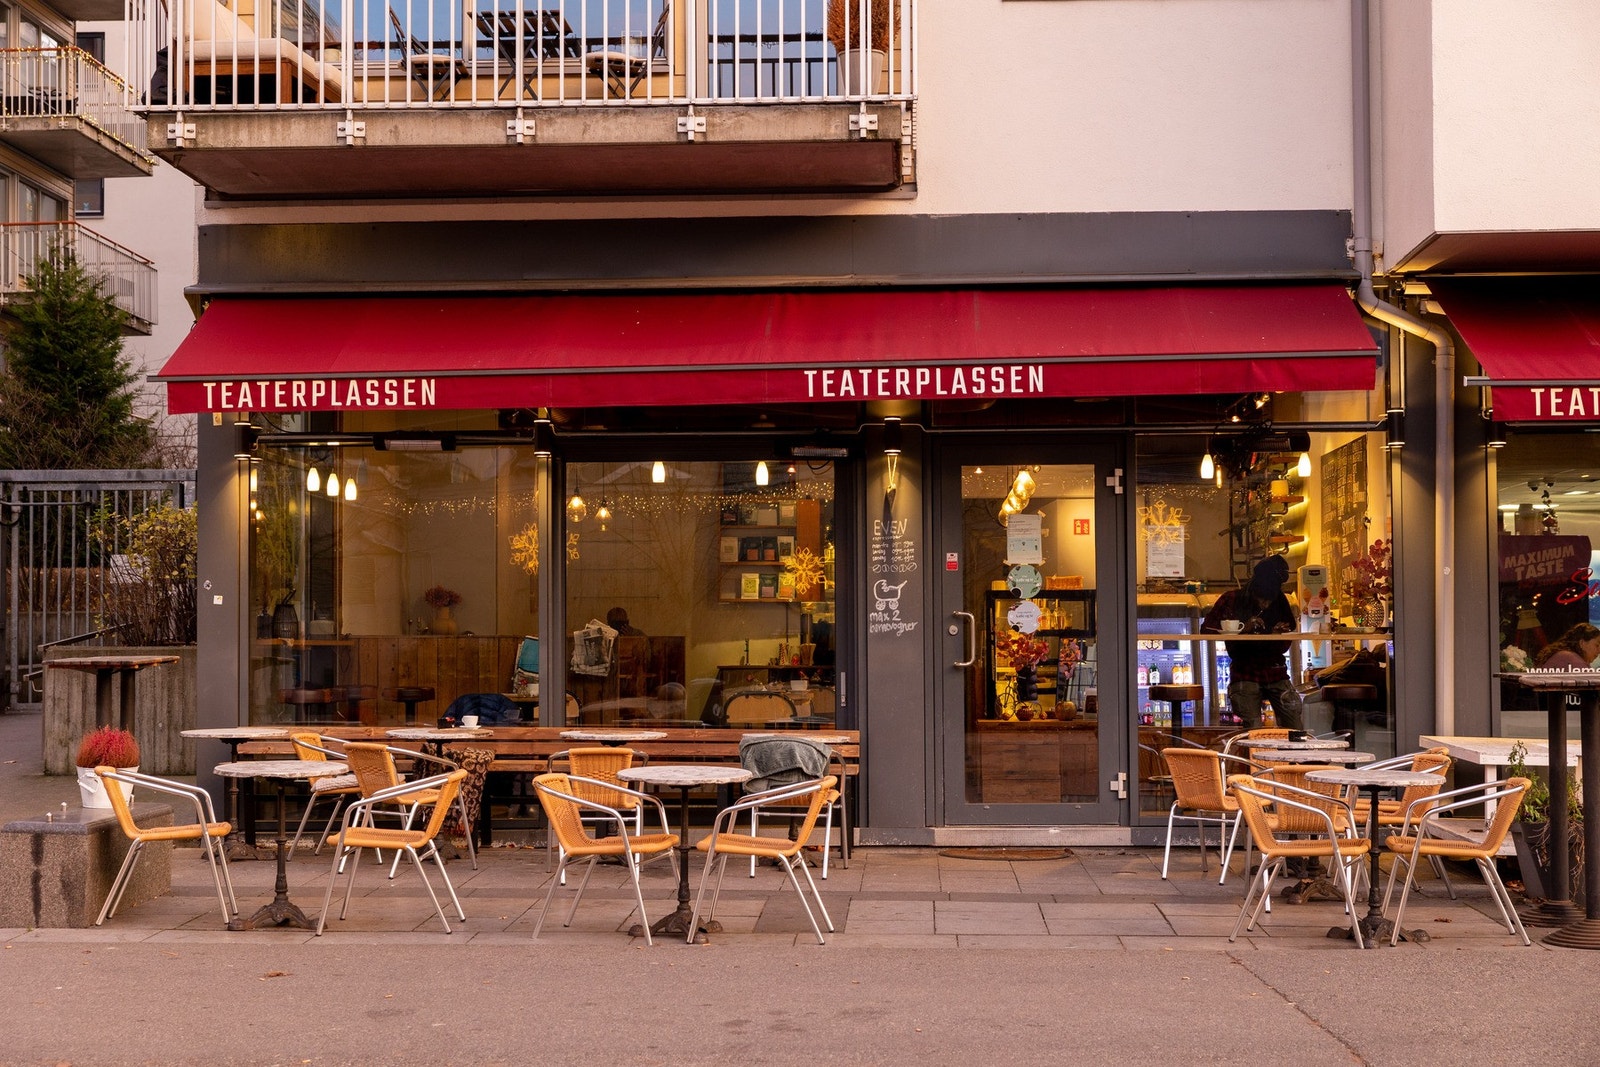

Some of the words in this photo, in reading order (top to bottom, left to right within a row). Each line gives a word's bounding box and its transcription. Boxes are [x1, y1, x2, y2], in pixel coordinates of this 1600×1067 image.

[203, 378, 436, 409] TEATERPLASSEN
[804, 365, 1044, 397] TEATERPLASSEN
[1530, 387, 1600, 416] TEAT
[873, 518, 908, 536] EVEN
[1504, 544, 1575, 569] MAXIMUM
[1515, 559, 1564, 581] TASTE
[869, 611, 890, 622] max
[892, 609, 902, 621] 2
